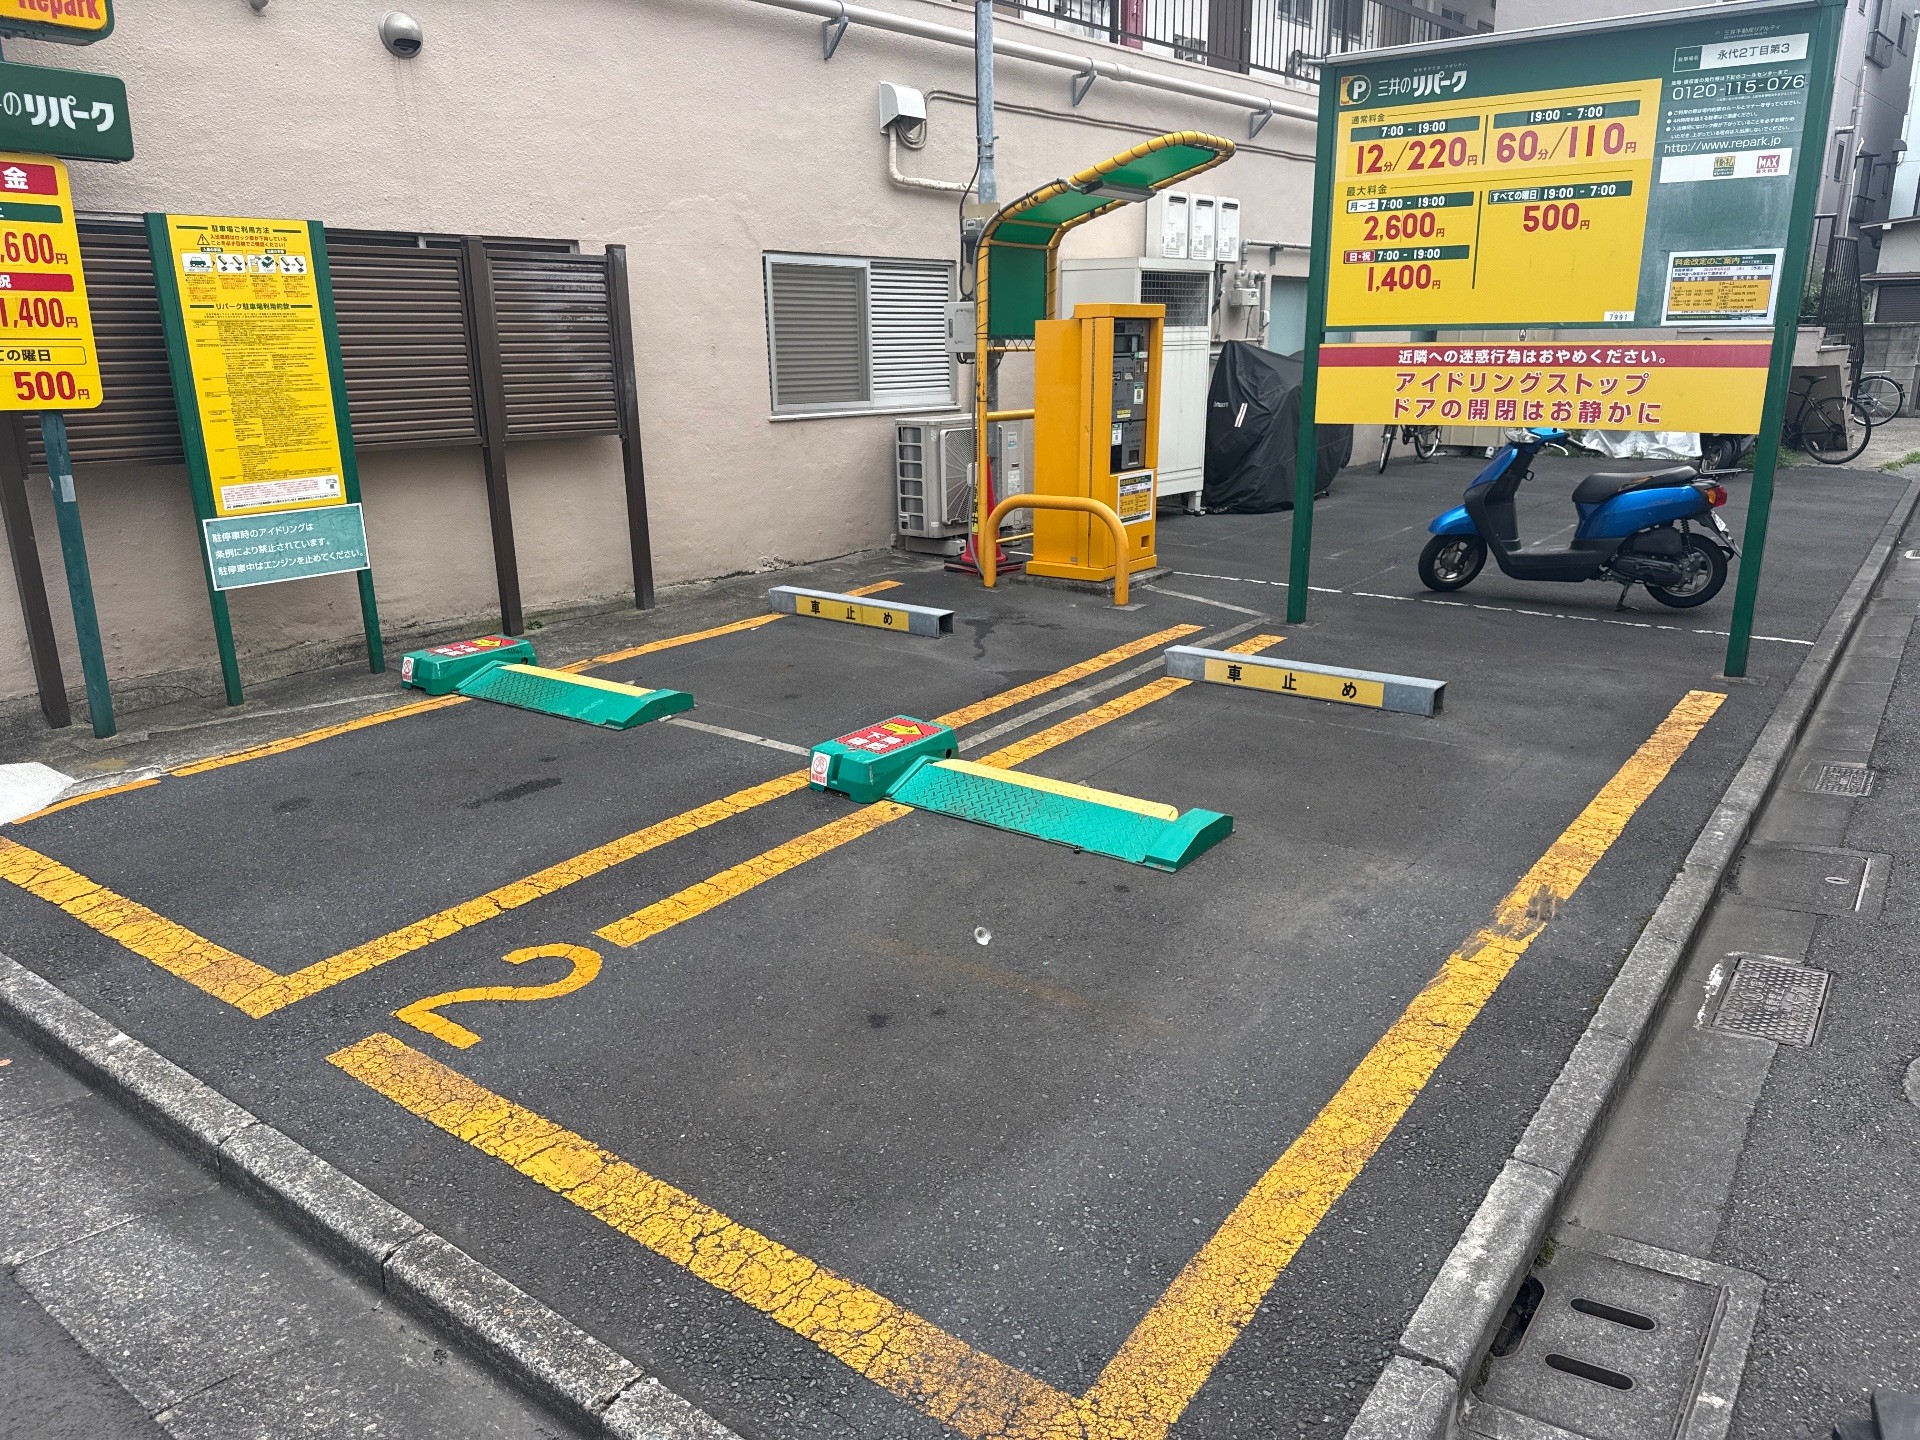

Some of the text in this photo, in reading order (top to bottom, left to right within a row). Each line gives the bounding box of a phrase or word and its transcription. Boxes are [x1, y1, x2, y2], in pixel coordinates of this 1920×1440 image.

[1717, 42, 1790, 61] 永代2丁目第3
[1377, 70, 1468, 98] 三井のリパーク
[1672, 74, 1805, 101] 0120-115-076
[0, 91, 115, 132] のリパーク
[1351, 113, 1386, 125] 通常料金
[1530, 109, 1561, 123] 19:00
[1577, 106, 1603, 119] 7:00
[1382, 125, 1404, 137] 7:00
[1418, 121, 1446, 134] 19:00
[1664, 135, 1782, 154] http://www.repark.jp
[1758, 156, 1779, 168] MAX
[2, 166, 29, 190] 金
[1346, 184, 1387, 197] 最大料金
[1492, 190, 1537, 202] すべての曜日
[1543, 187, 1574, 199] 19:00
[1590, 184, 1616, 197] 7:00
[1381, 198, 1403, 210] 7:00
[1418, 196, 1445, 208] 19:00
[1363, 211, 1445, 242] 2,600円
[1523, 202, 1590, 233] 500円
[211, 225, 270, 235] 駐車場ご利用方法
[1349, 252, 1371, 262] 日・祝
[1377, 250, 1400, 261] 7:00
[1413, 249, 1440, 260] 19:00
[1674, 257, 1740, 266] 料金改定のご案内
[1367, 264, 1441, 292] 1,400円
[0, 297, 79, 328] 1,400円
[1398, 347, 1667, 365] 近隣への迷惑行為はおやめください。
[13, 371, 90, 401] 500円
[1394, 371, 1651, 395] アイドリングストップ
[1393, 398, 1662, 425] ドアの開閉はお静かに
[212, 522, 314, 543] 駐停車時のアイドリングは
[215, 537, 330, 560] 条例により禁止されています。
[218, 549, 364, 577] 駐停車中はエンジンを止めてください。
[810, 600, 893, 626] 車止め
[1226, 664, 1358, 699] 車止め
[390, 942, 603, 1050] 2
